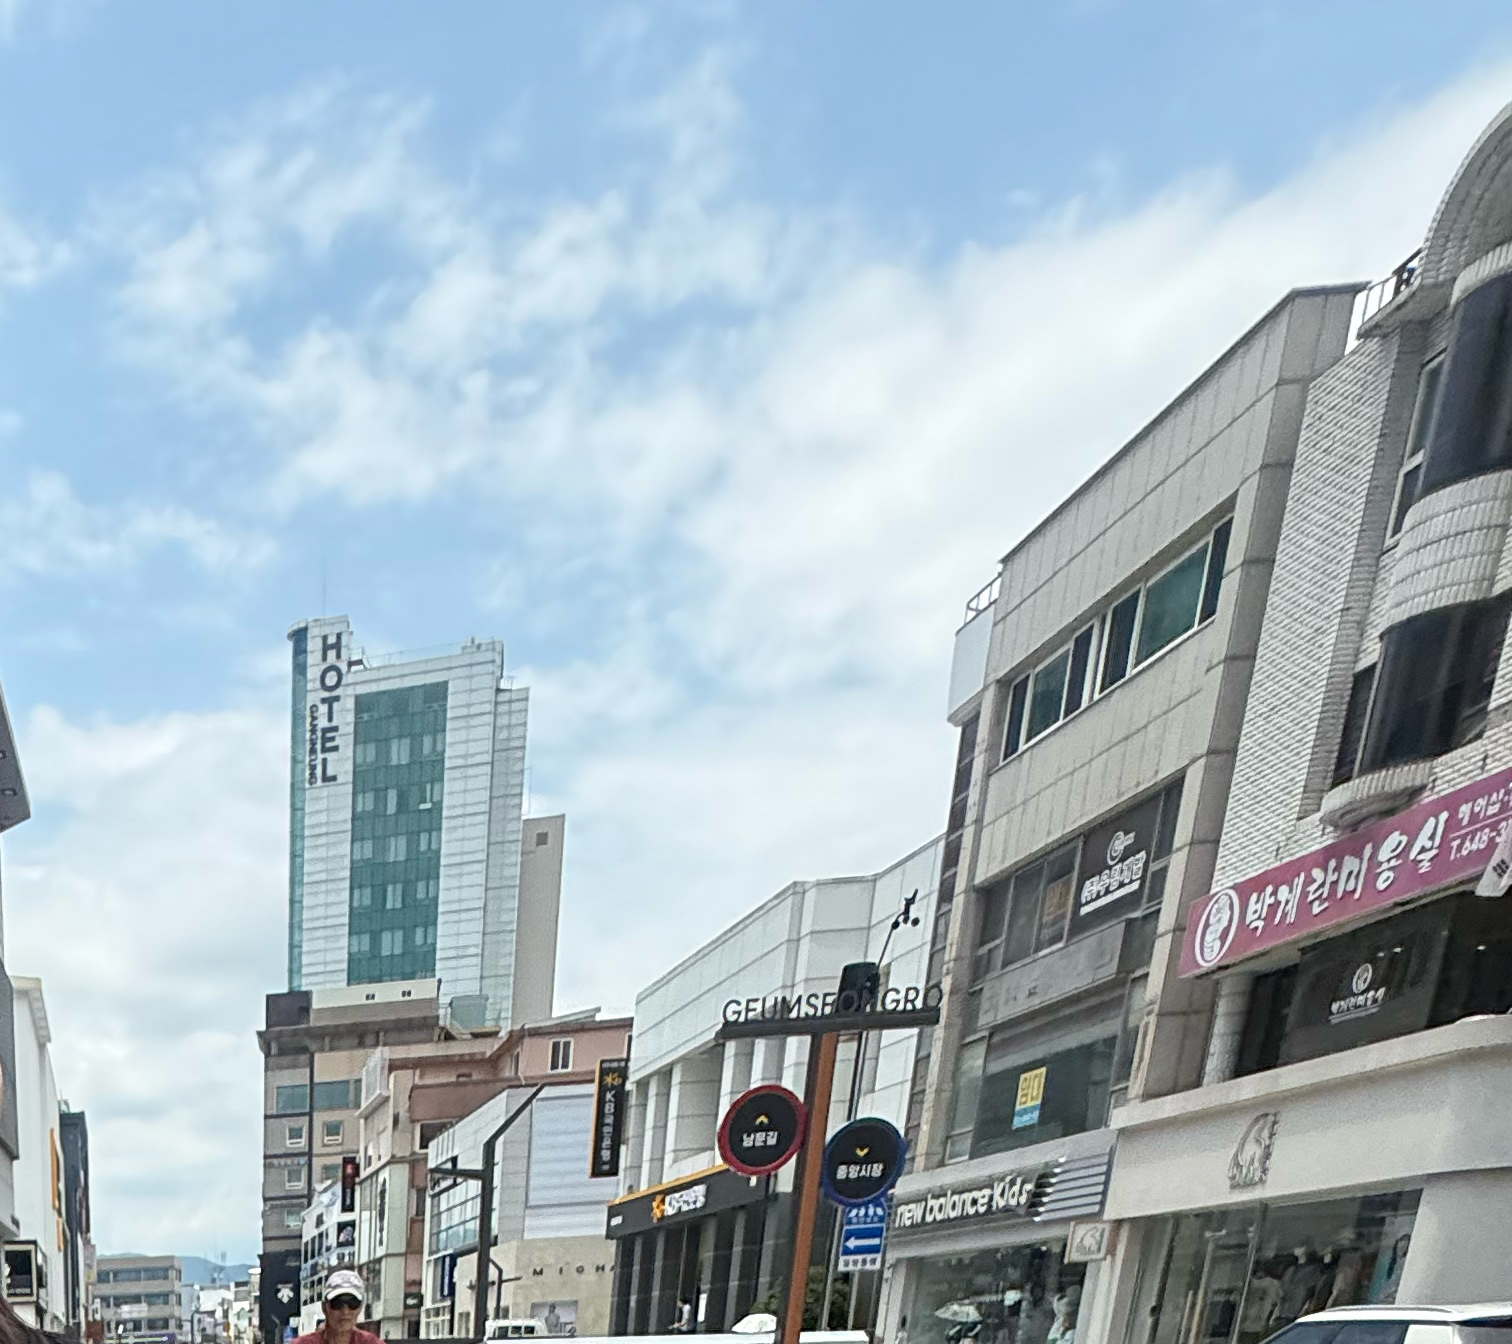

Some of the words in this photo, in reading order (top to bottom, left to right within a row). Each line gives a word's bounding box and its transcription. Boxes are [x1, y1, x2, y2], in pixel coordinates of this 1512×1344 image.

[320, 632, 343, 783] HOTEL
[308, 704, 319, 786] GANGNEUNG
[1018, 1071, 1044, 1107] 임대
[742, 1130, 779, 1148] 남문길
[836, 1162, 885, 1180] 중앙시장
[895, 1200, 926, 1228] new
[926, 1188, 992, 1223] balance
[992, 1175, 1035, 1211] Kids
